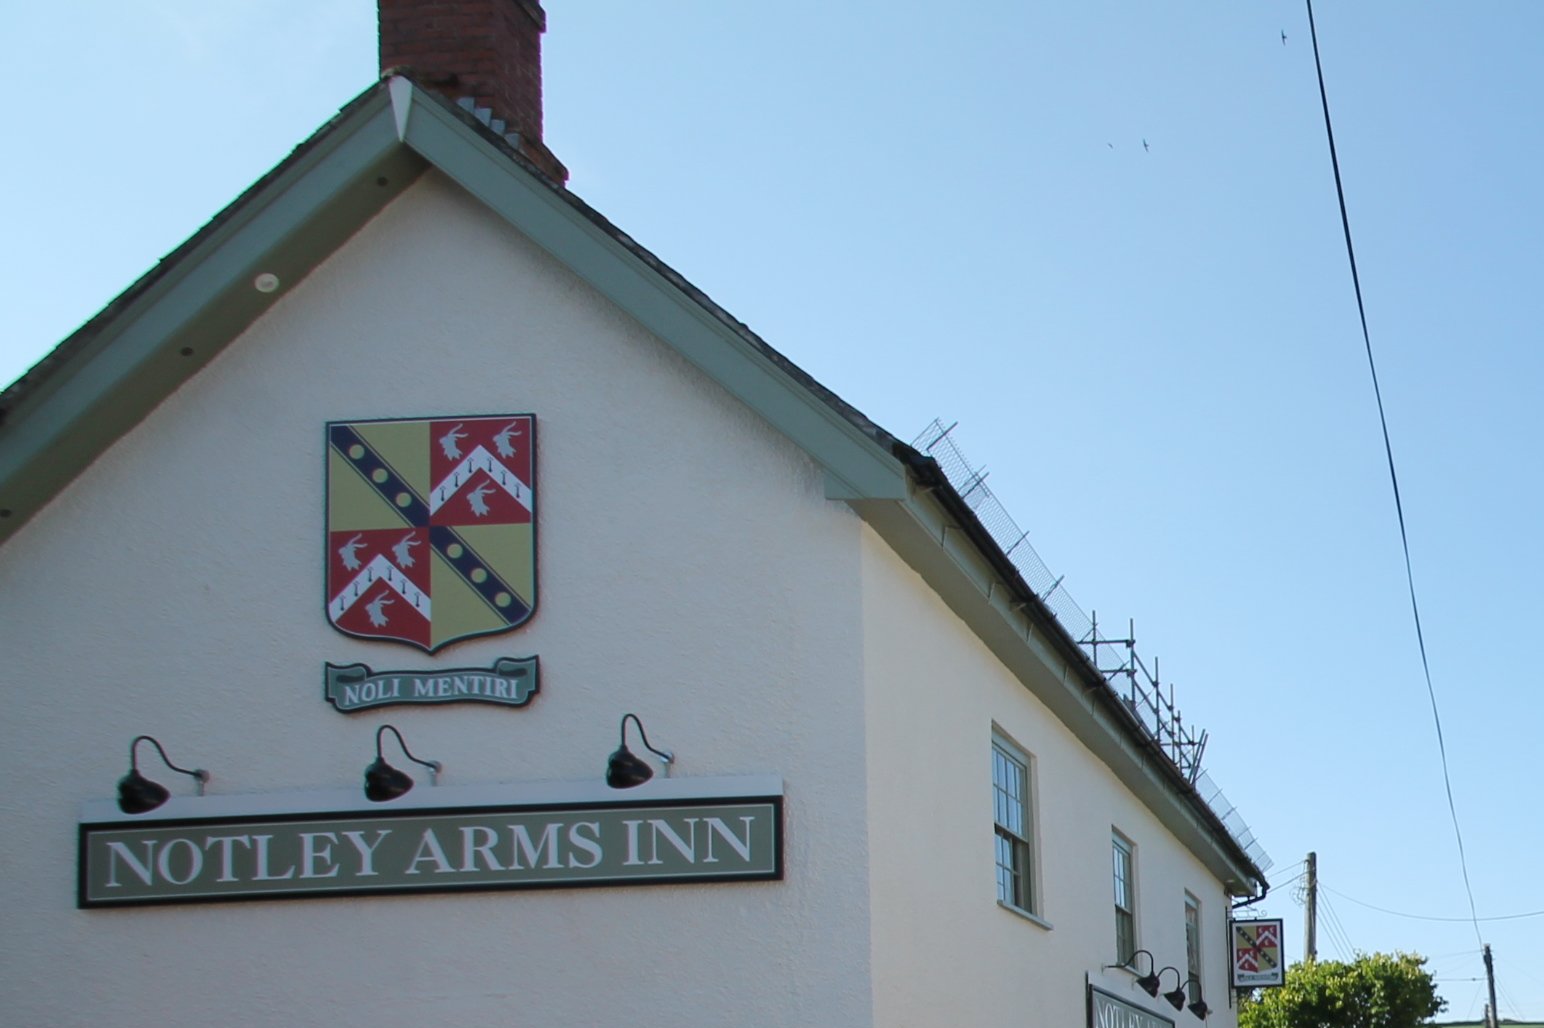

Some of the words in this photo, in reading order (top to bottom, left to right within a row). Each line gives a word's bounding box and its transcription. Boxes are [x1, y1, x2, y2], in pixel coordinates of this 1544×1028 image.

[343, 677, 401, 706] NOLI
[414, 675, 520, 700] MENTIRI
[104, 828, 393, 888] NOTLEY
[405, 820, 602, 876] ARMS
[621, 816, 755, 867] INN
